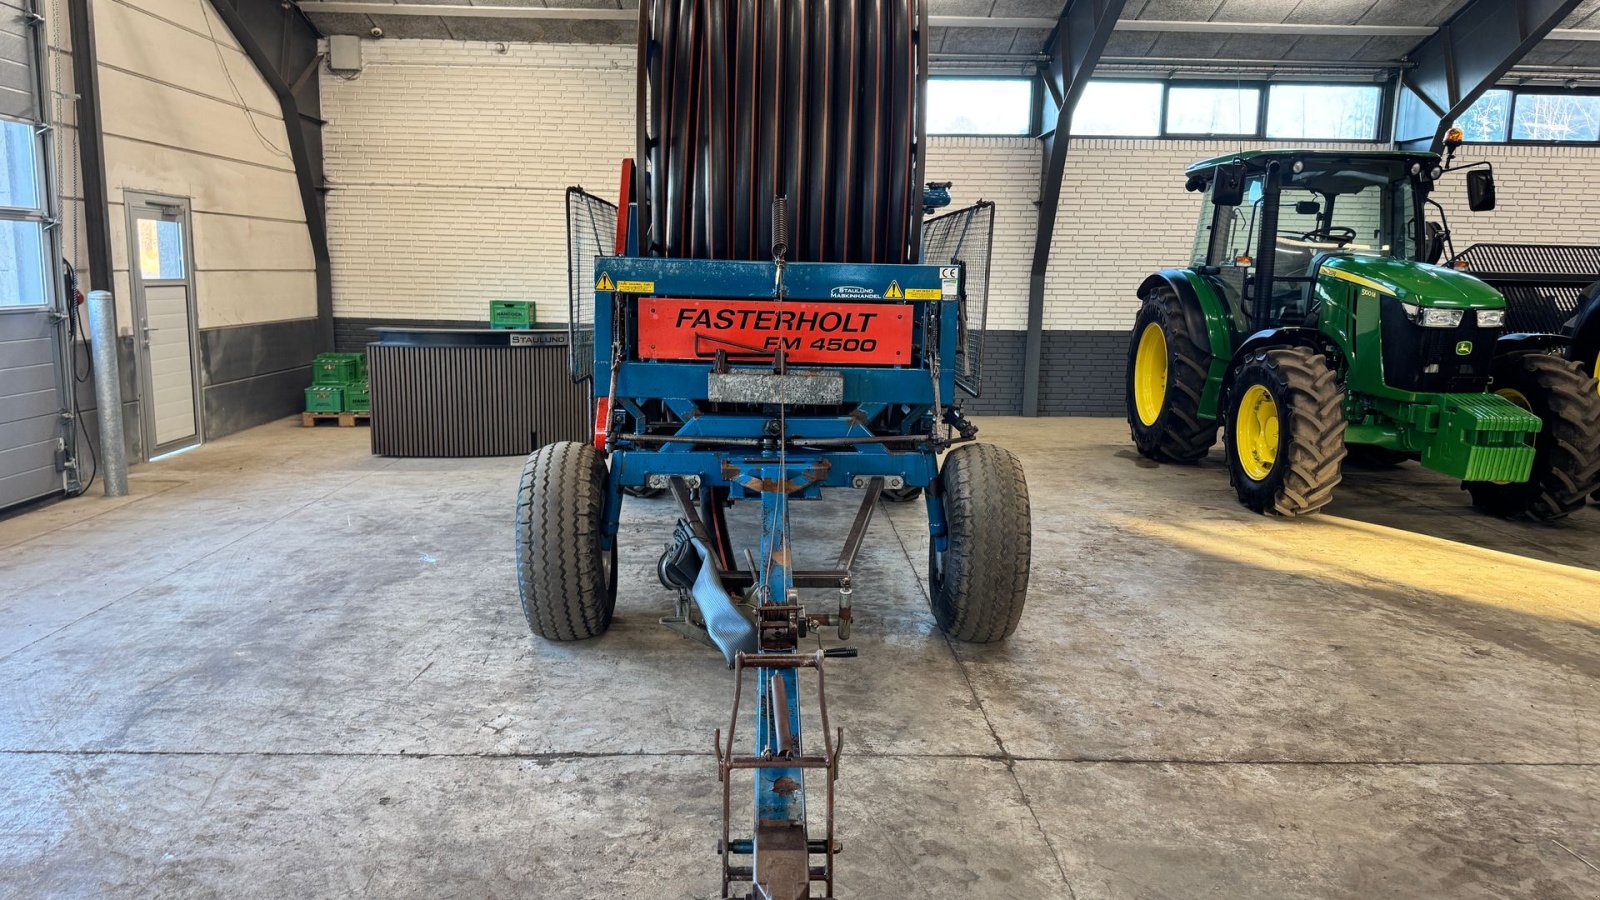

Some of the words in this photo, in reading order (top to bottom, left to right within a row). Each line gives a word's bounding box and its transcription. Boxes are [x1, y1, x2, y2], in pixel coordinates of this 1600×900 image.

[675, 308, 878, 333] FASTERHOLT
[512, 336, 565, 344] STAULUND
[763, 336, 802, 350] FM
[809, 337, 877, 352] 4500
